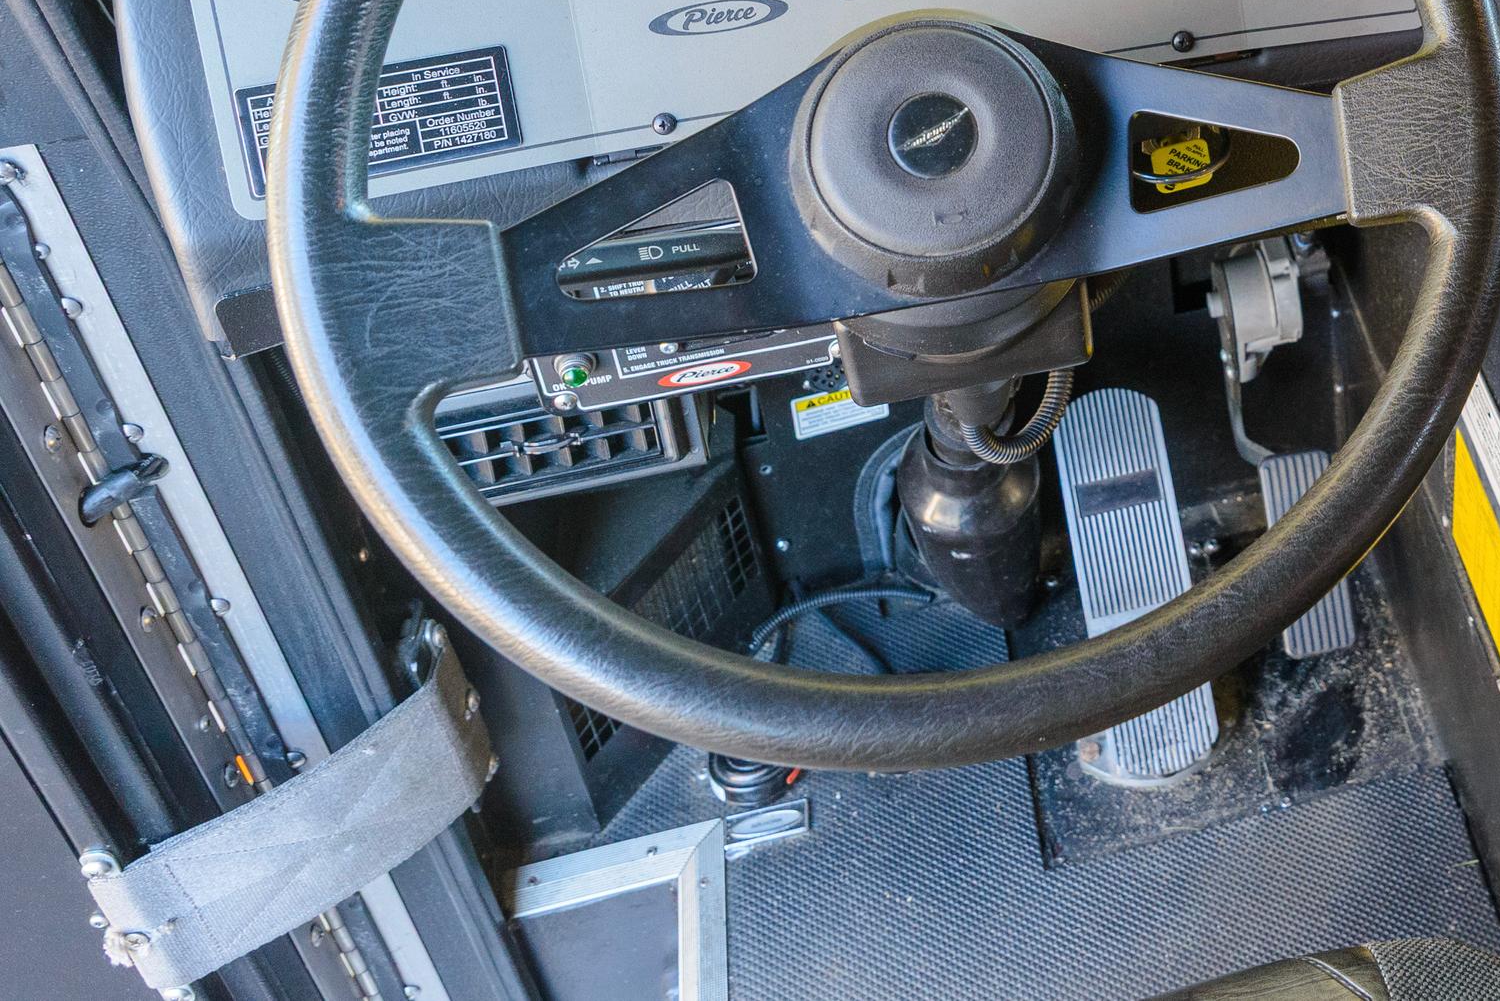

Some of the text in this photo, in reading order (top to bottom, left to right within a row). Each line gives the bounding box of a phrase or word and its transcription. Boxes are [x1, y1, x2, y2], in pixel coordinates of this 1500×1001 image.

[682, 6, 756, 30] Pierce
[412, 67, 460, 81] In Service
[383, 74, 485, 97] Height: ft. in.
[384, 86, 487, 109] Length: ft. in.
[389, 98, 489, 122] GVW: lb.
[426, 108, 496, 127] Order Number
[383, 128, 410, 139] placing
[440, 121, 487, 136] 11605520
[375, 140, 385, 148] be
[386, 136, 408, 146] noted
[434, 131, 496, 149] P/N 1427180
[1169, 149, 1208, 169] PARKING
[671, 243, 700, 254] PULL
[608, 282, 627, 292] SHIFT
[626, 346, 646, 355] LEVER
[628, 353, 647, 361] DOWN
[630, 361, 655, 372] ENGAGE
[657, 358, 678, 367] TRUCK
[679, 348, 725, 363] TRANSMISSION
[678, 365, 735, 382] Pierce
[552, 383, 566, 392] OK
